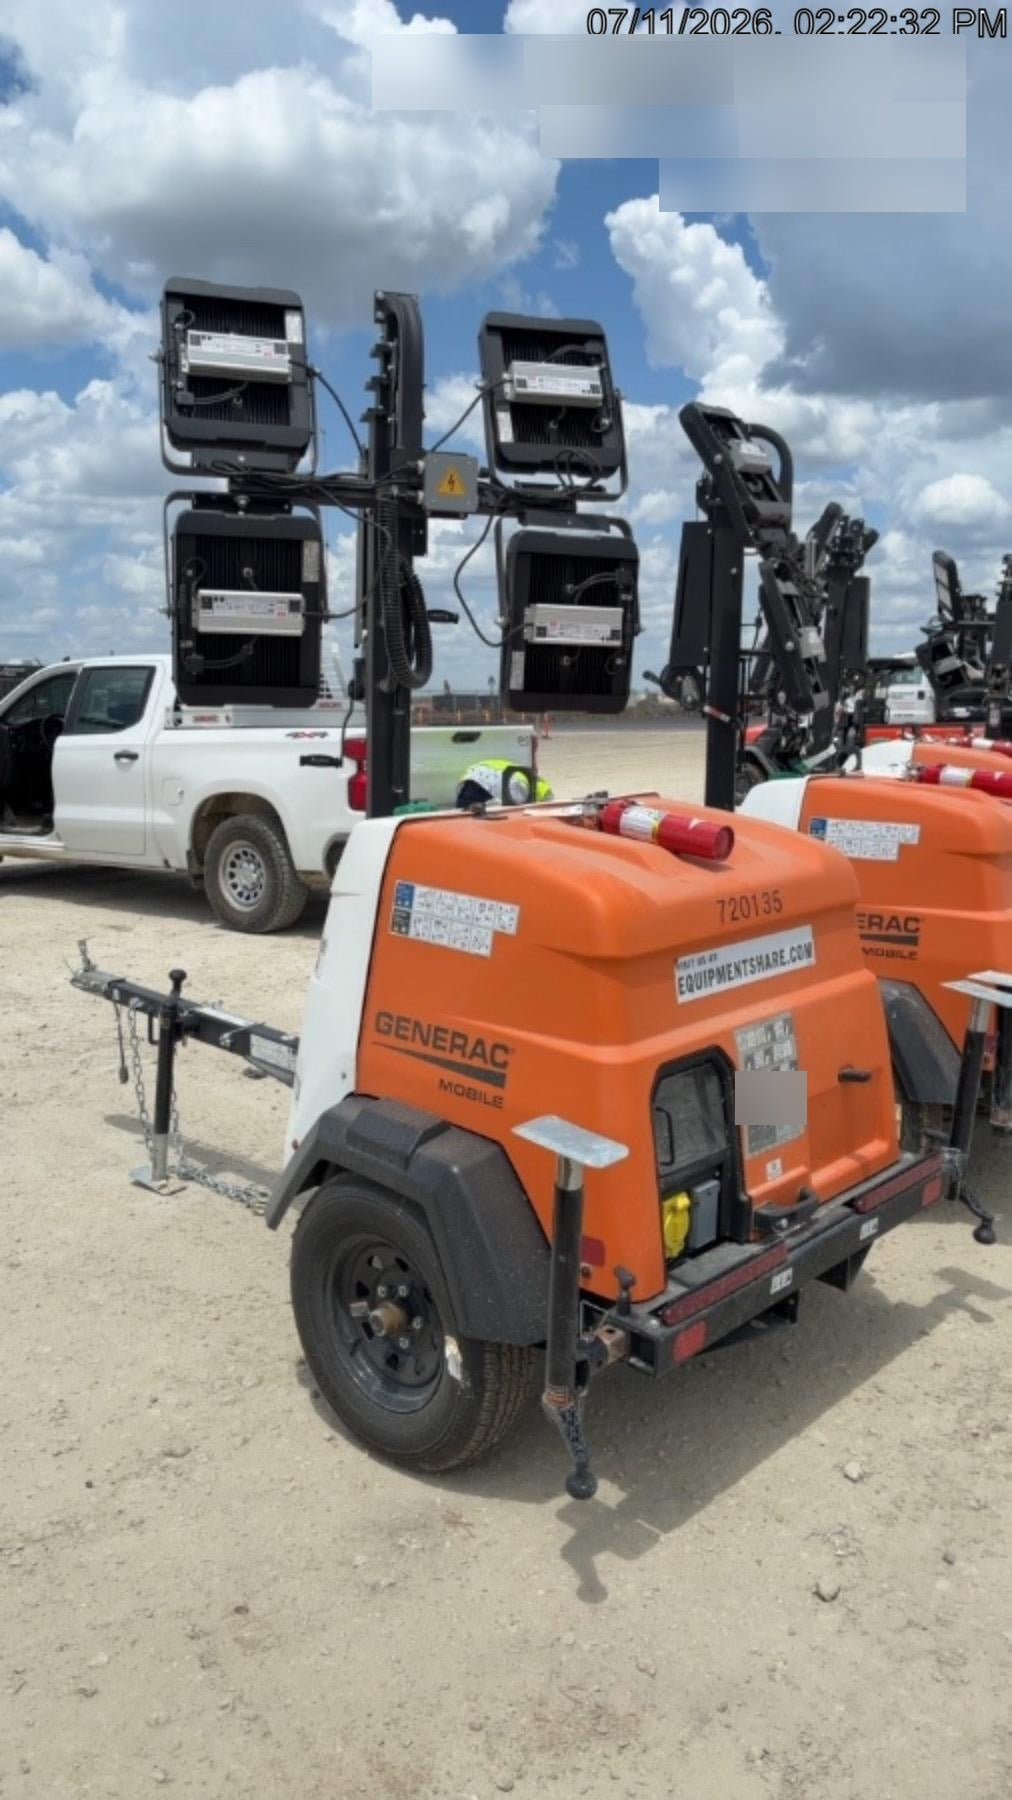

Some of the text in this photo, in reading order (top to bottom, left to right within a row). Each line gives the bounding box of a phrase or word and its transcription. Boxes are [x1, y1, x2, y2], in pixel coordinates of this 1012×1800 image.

[716, 890, 784, 924] 720135
[856, 913, 921, 934] ERAC
[677, 941, 814, 996] EQUIPMENTSHARE.COM
[374, 1010, 511, 1071] GENERAC
[438, 1077, 505, 1110] MOBILE
